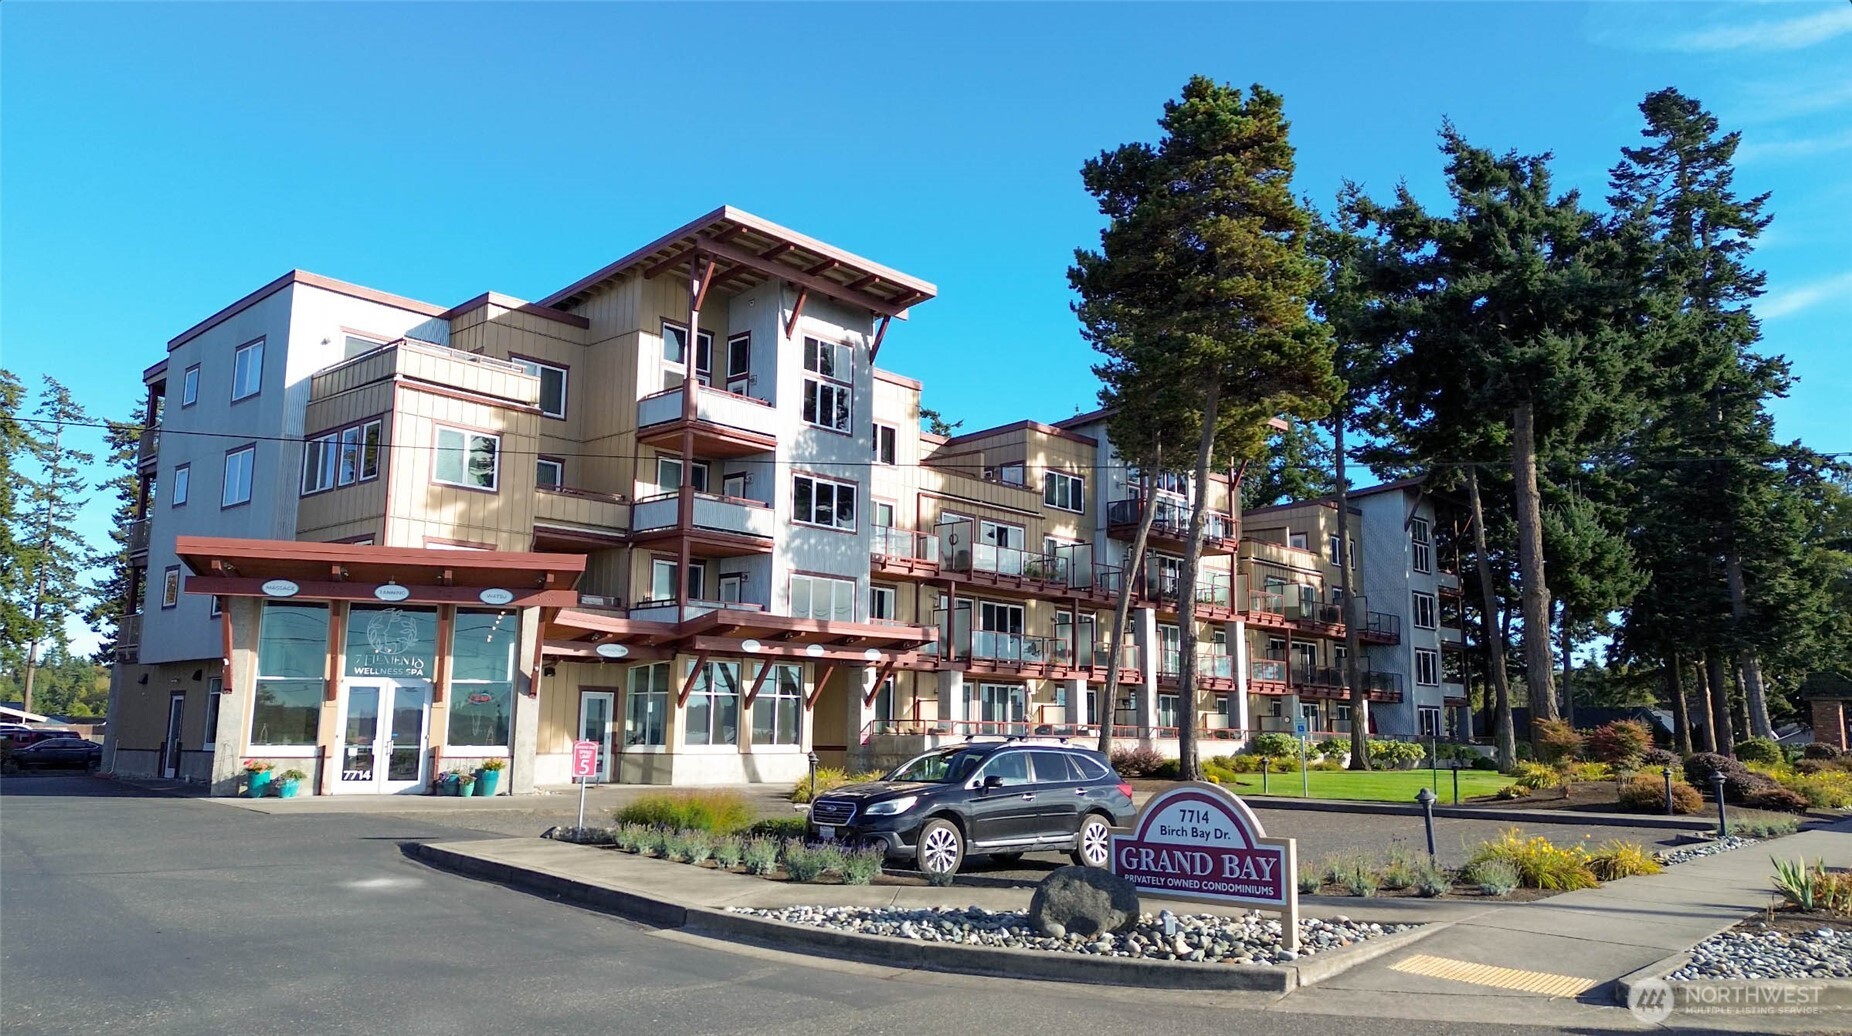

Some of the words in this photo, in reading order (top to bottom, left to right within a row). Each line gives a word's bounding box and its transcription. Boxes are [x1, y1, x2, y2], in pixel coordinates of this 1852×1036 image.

[354, 666, 404, 675] WELLNESS
[405, 668, 424, 676] SPA
[579, 759, 590, 775] 5
[343, 770, 372, 781] 7714
[1179, 809, 1210, 824] 7714
[1160, 825, 1188, 837] Birch
[1191, 827, 1211, 842] Bay
[1214, 828, 1231, 840] Dr.
[1120, 846, 1214, 876] GRAND
[1221, 854, 1278, 882] BAY
[1124, 874, 1166, 886] PRIVATELY
[1167, 877, 1200, 889] OWNED
[1201, 881, 1275, 896] CONDOMINIUMS
